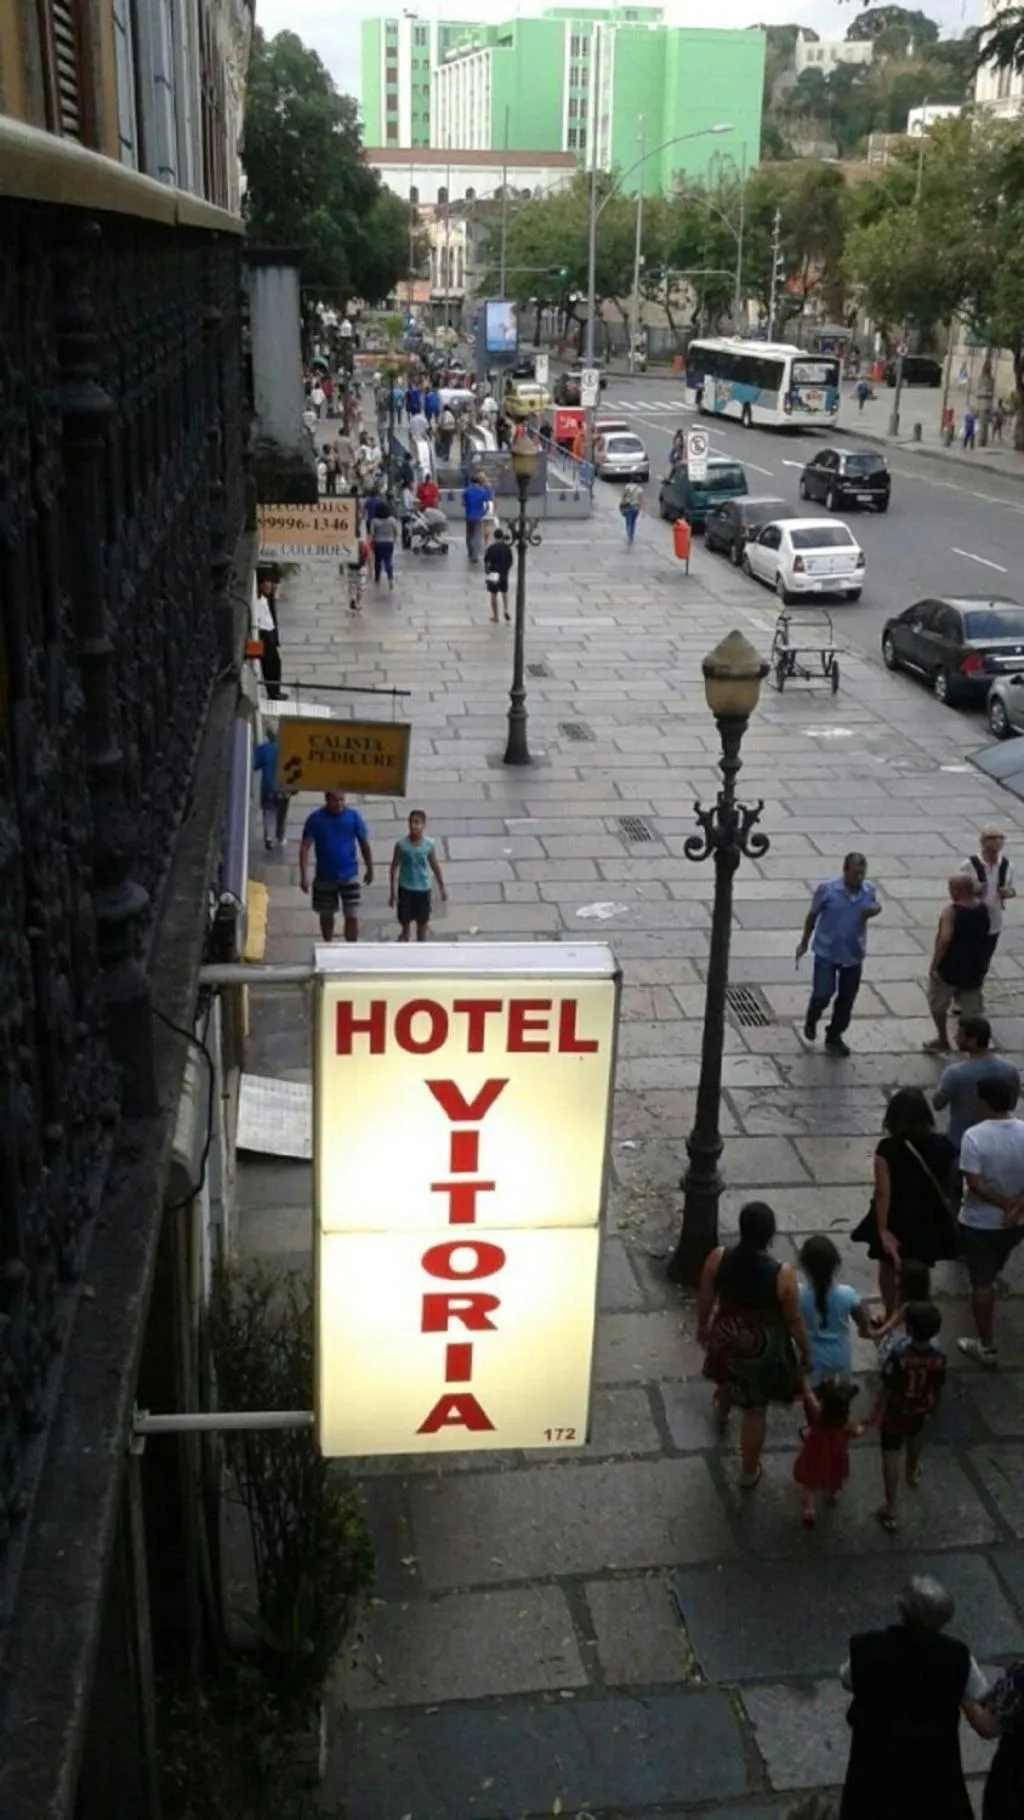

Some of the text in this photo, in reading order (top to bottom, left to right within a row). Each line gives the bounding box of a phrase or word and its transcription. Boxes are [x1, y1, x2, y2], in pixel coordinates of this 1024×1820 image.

[308, 734, 383, 753] CALISTA
[308, 749, 397, 767] PEDICURE
[334, 998, 599, 1055] HOTEL
[416, 1078, 510, 1434] VITORIA
[543, 1427, 576, 1442] 172
